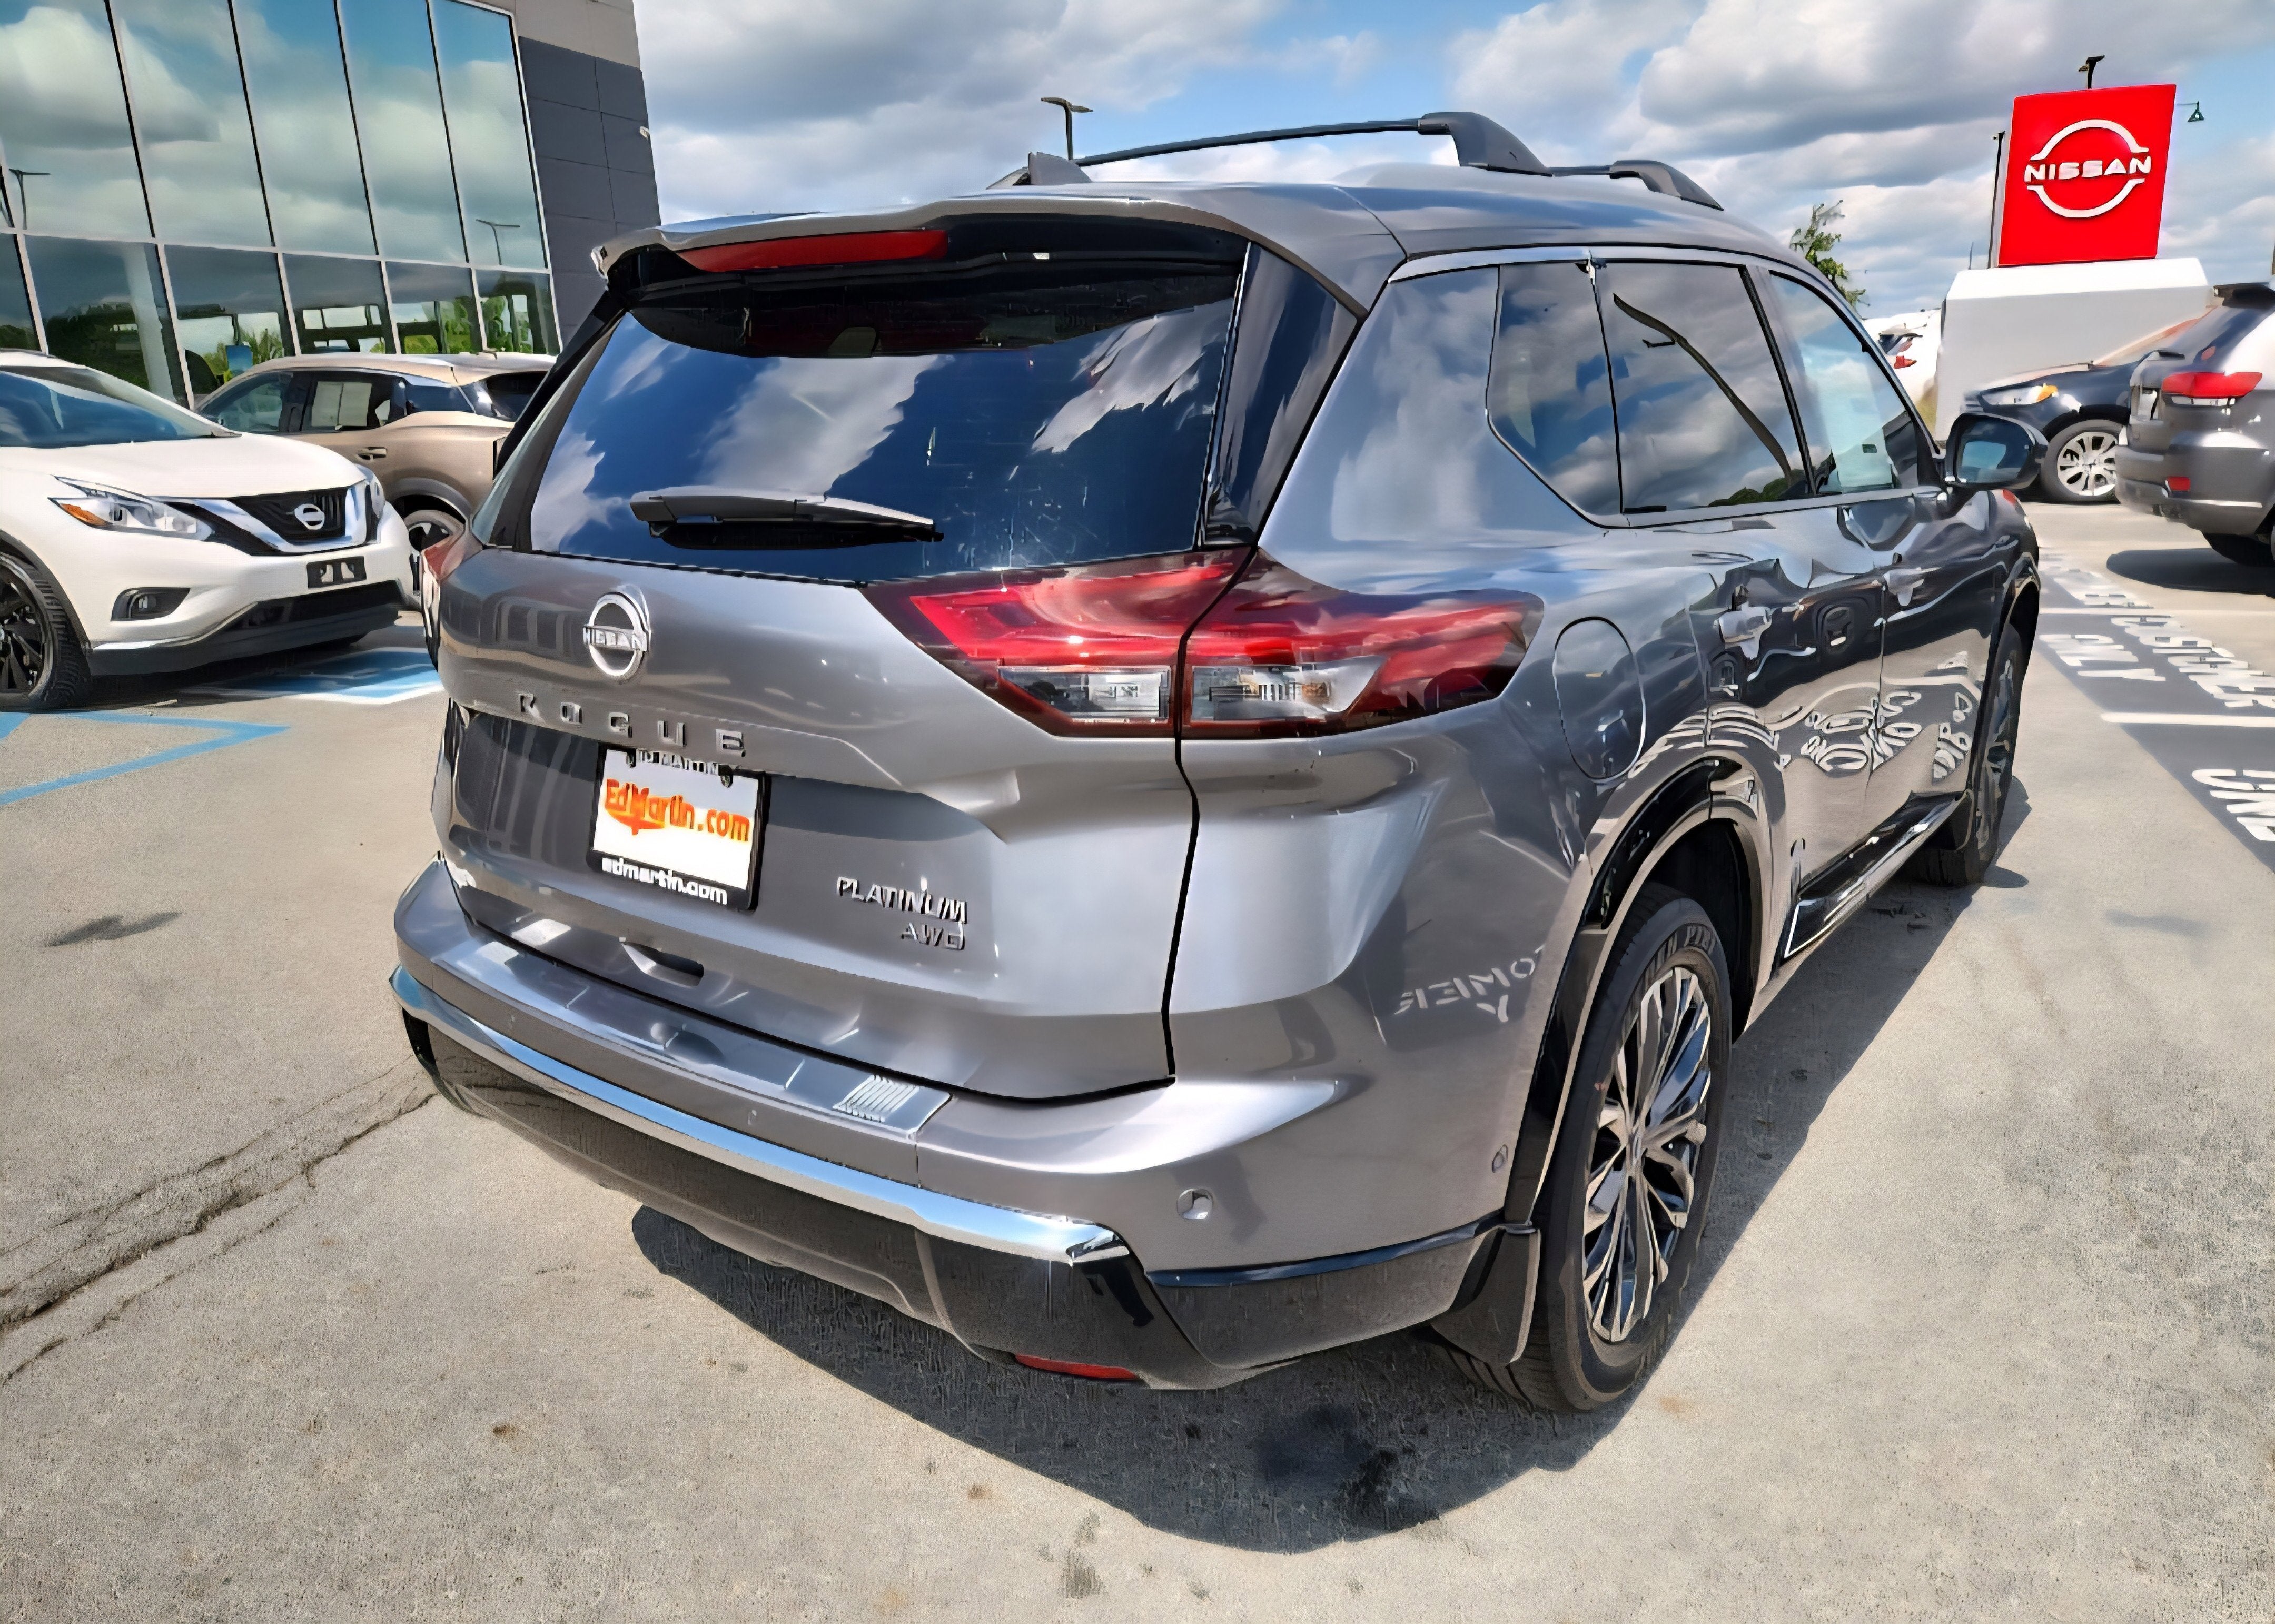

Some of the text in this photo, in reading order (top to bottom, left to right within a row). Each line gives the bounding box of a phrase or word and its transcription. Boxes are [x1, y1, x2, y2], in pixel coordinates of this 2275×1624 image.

[2024, 155, 2151, 183] NISSAN
[518, 692, 745, 754] ROGUE
[605, 778, 750, 842] EdMartin.com
[601, 857, 728, 905] edmartin.com
[836, 877, 968, 924] PLATINUM
[901, 922, 965, 950] AWD
